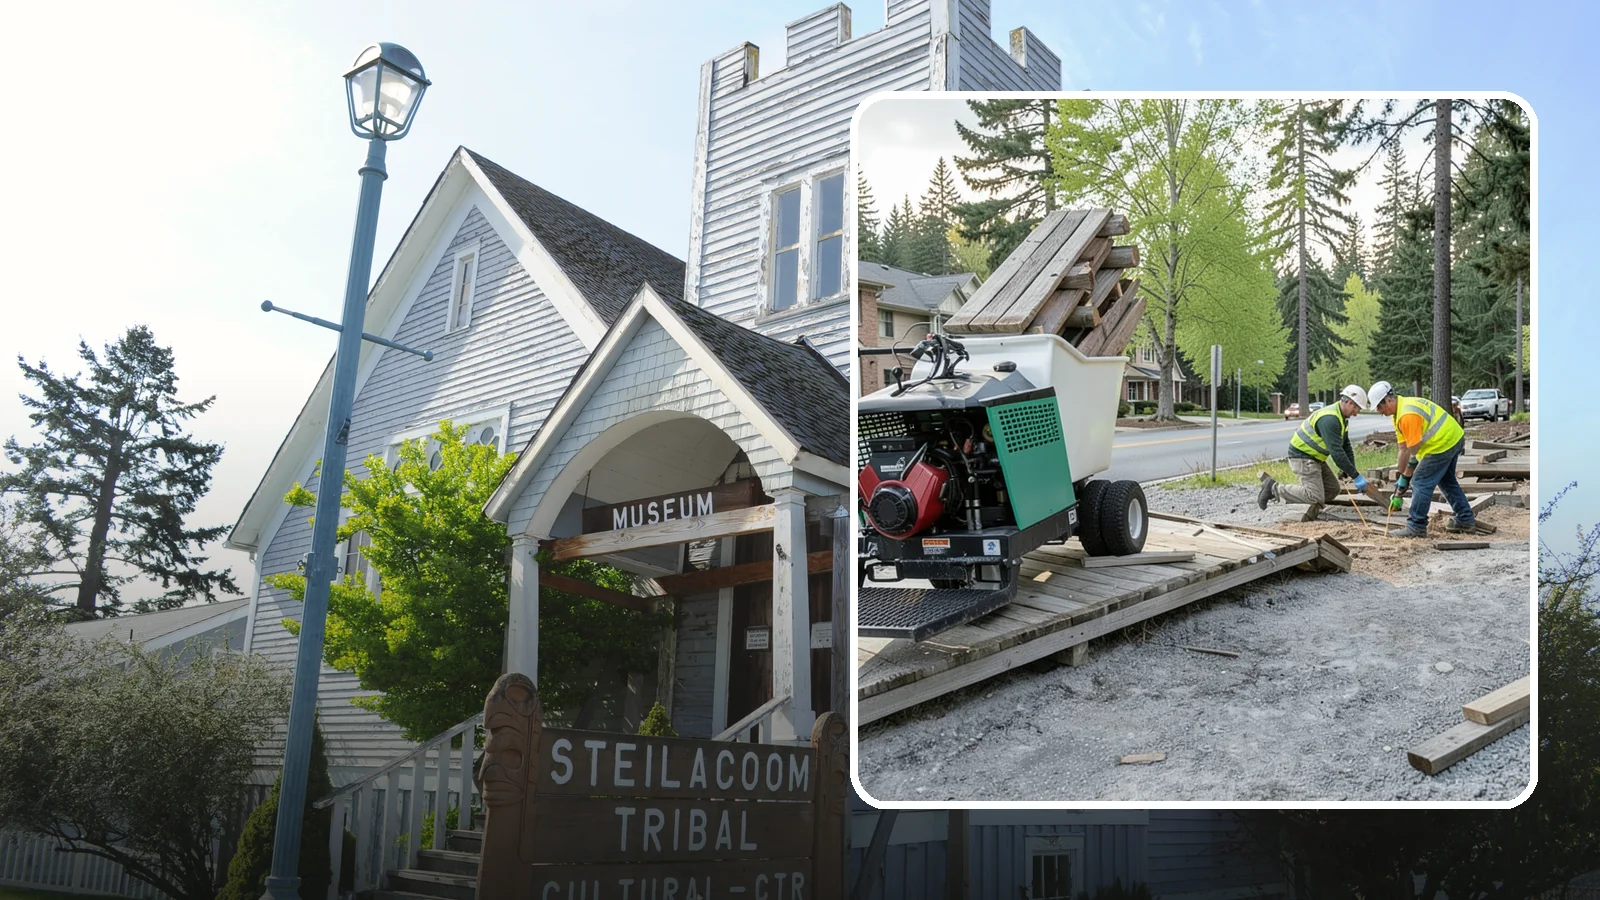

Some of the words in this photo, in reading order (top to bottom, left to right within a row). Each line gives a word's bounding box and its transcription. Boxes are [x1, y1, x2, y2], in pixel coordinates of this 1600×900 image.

[612, 491, 714, 530] MUSEUM
[550, 738, 810, 793] STEILACOOM
[614, 806, 758, 852] TRIBAL
[754, 871, 805, 900] CTR
